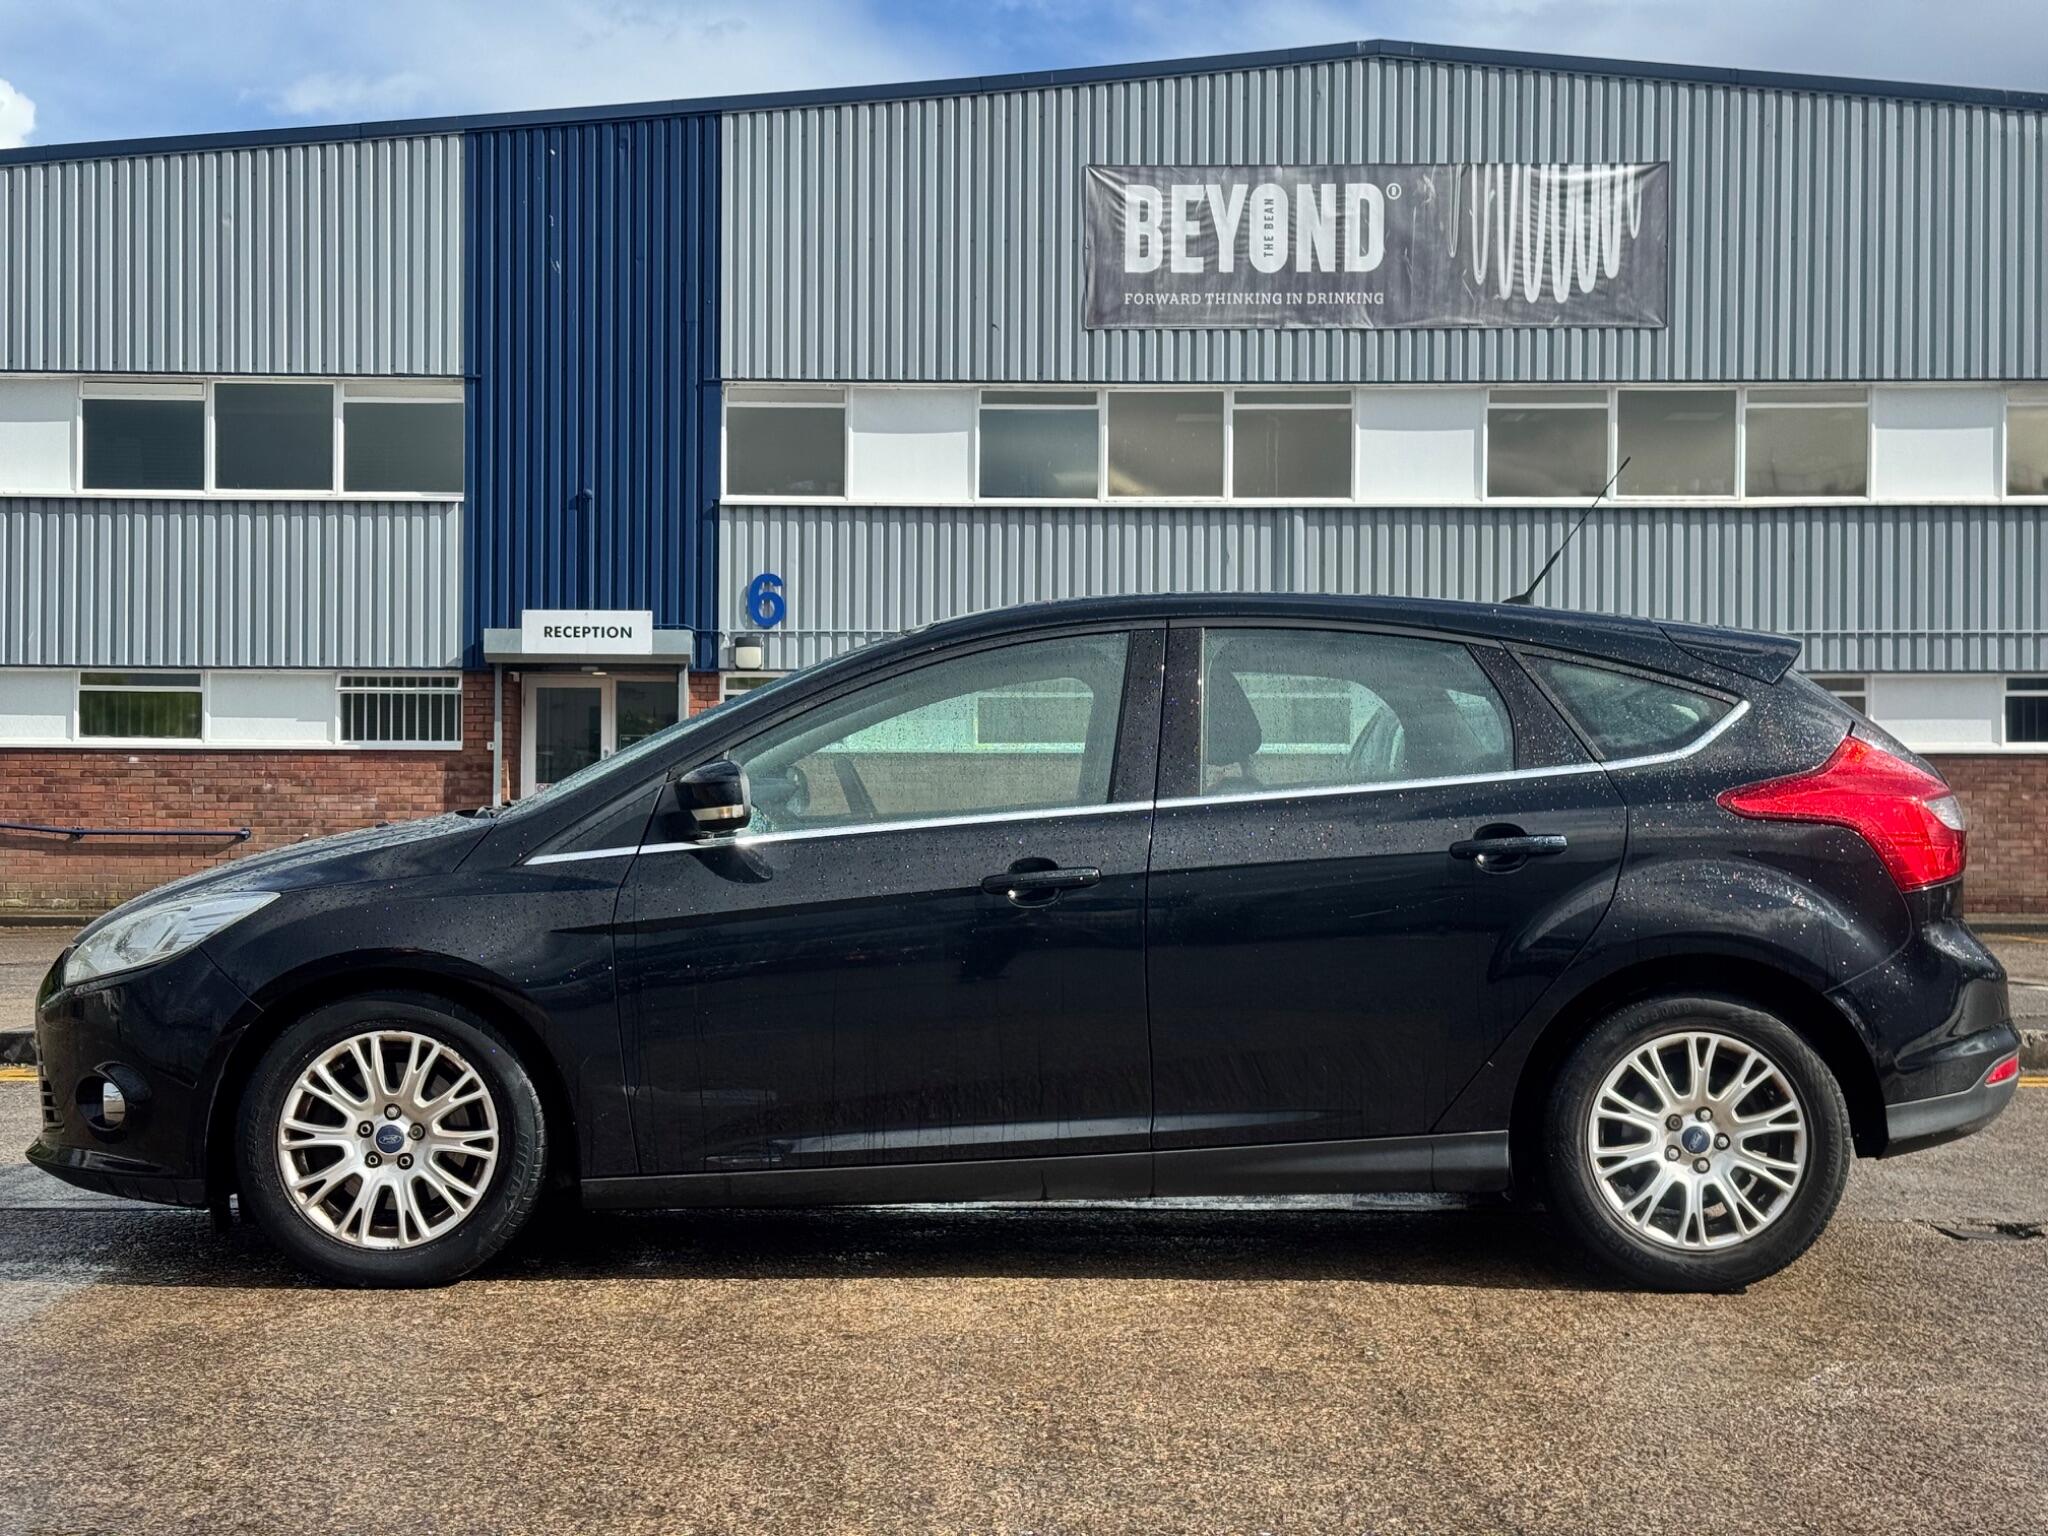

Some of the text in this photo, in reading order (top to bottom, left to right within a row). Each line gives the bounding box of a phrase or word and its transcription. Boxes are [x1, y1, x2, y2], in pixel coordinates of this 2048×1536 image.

[1124, 183, 1385, 273] BEYOND
[1263, 198, 1274, 257] THE BEAN
[1124, 292, 1385, 305] FORWARD THINKING IN DRINKING
[747, 573, 786, 628] 6
[543, 625, 633, 638] RECEPTION
